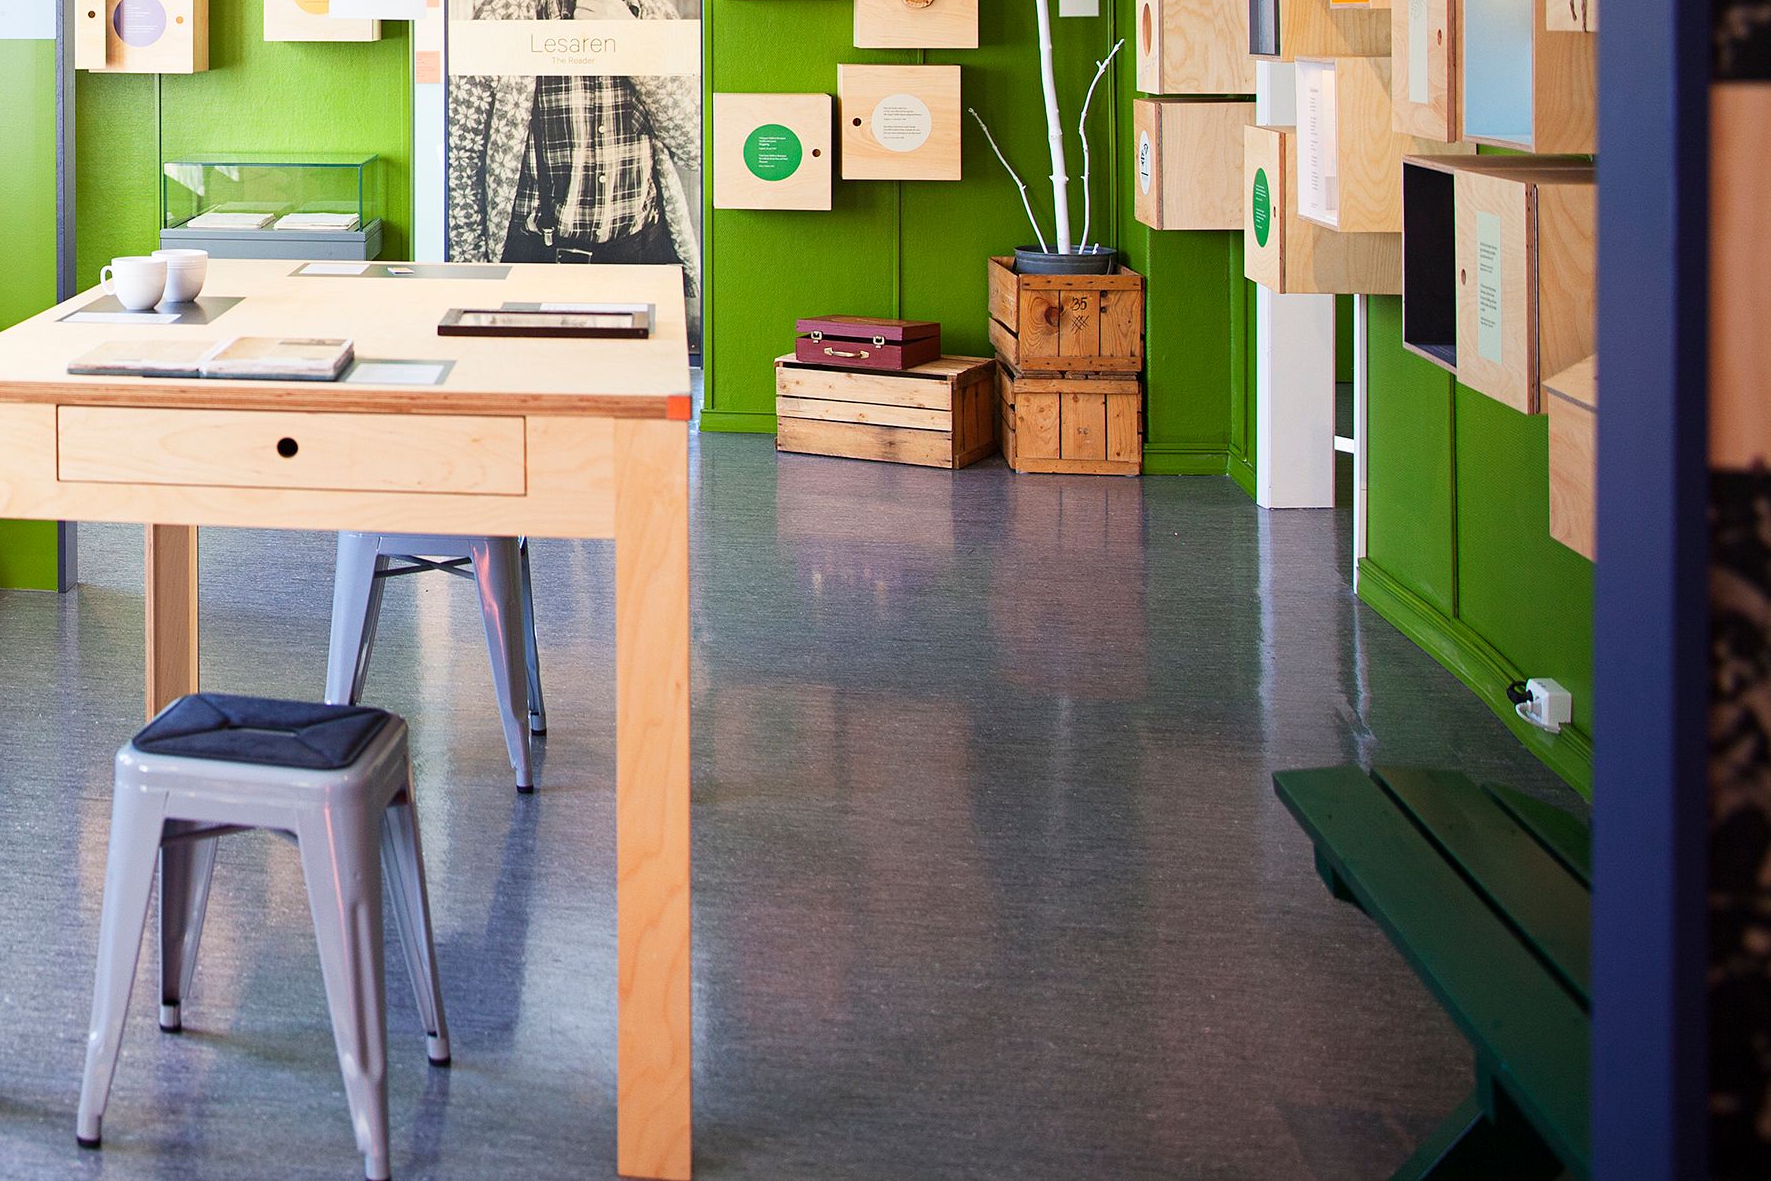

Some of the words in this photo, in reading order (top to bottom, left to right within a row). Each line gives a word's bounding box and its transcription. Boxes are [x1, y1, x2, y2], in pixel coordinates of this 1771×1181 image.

[530, 34, 616, 53] Lesaren
[552, 57, 566, 65] The
[568, 57, 595, 65] Reader
[1071, 296, 1088, 311] 35
